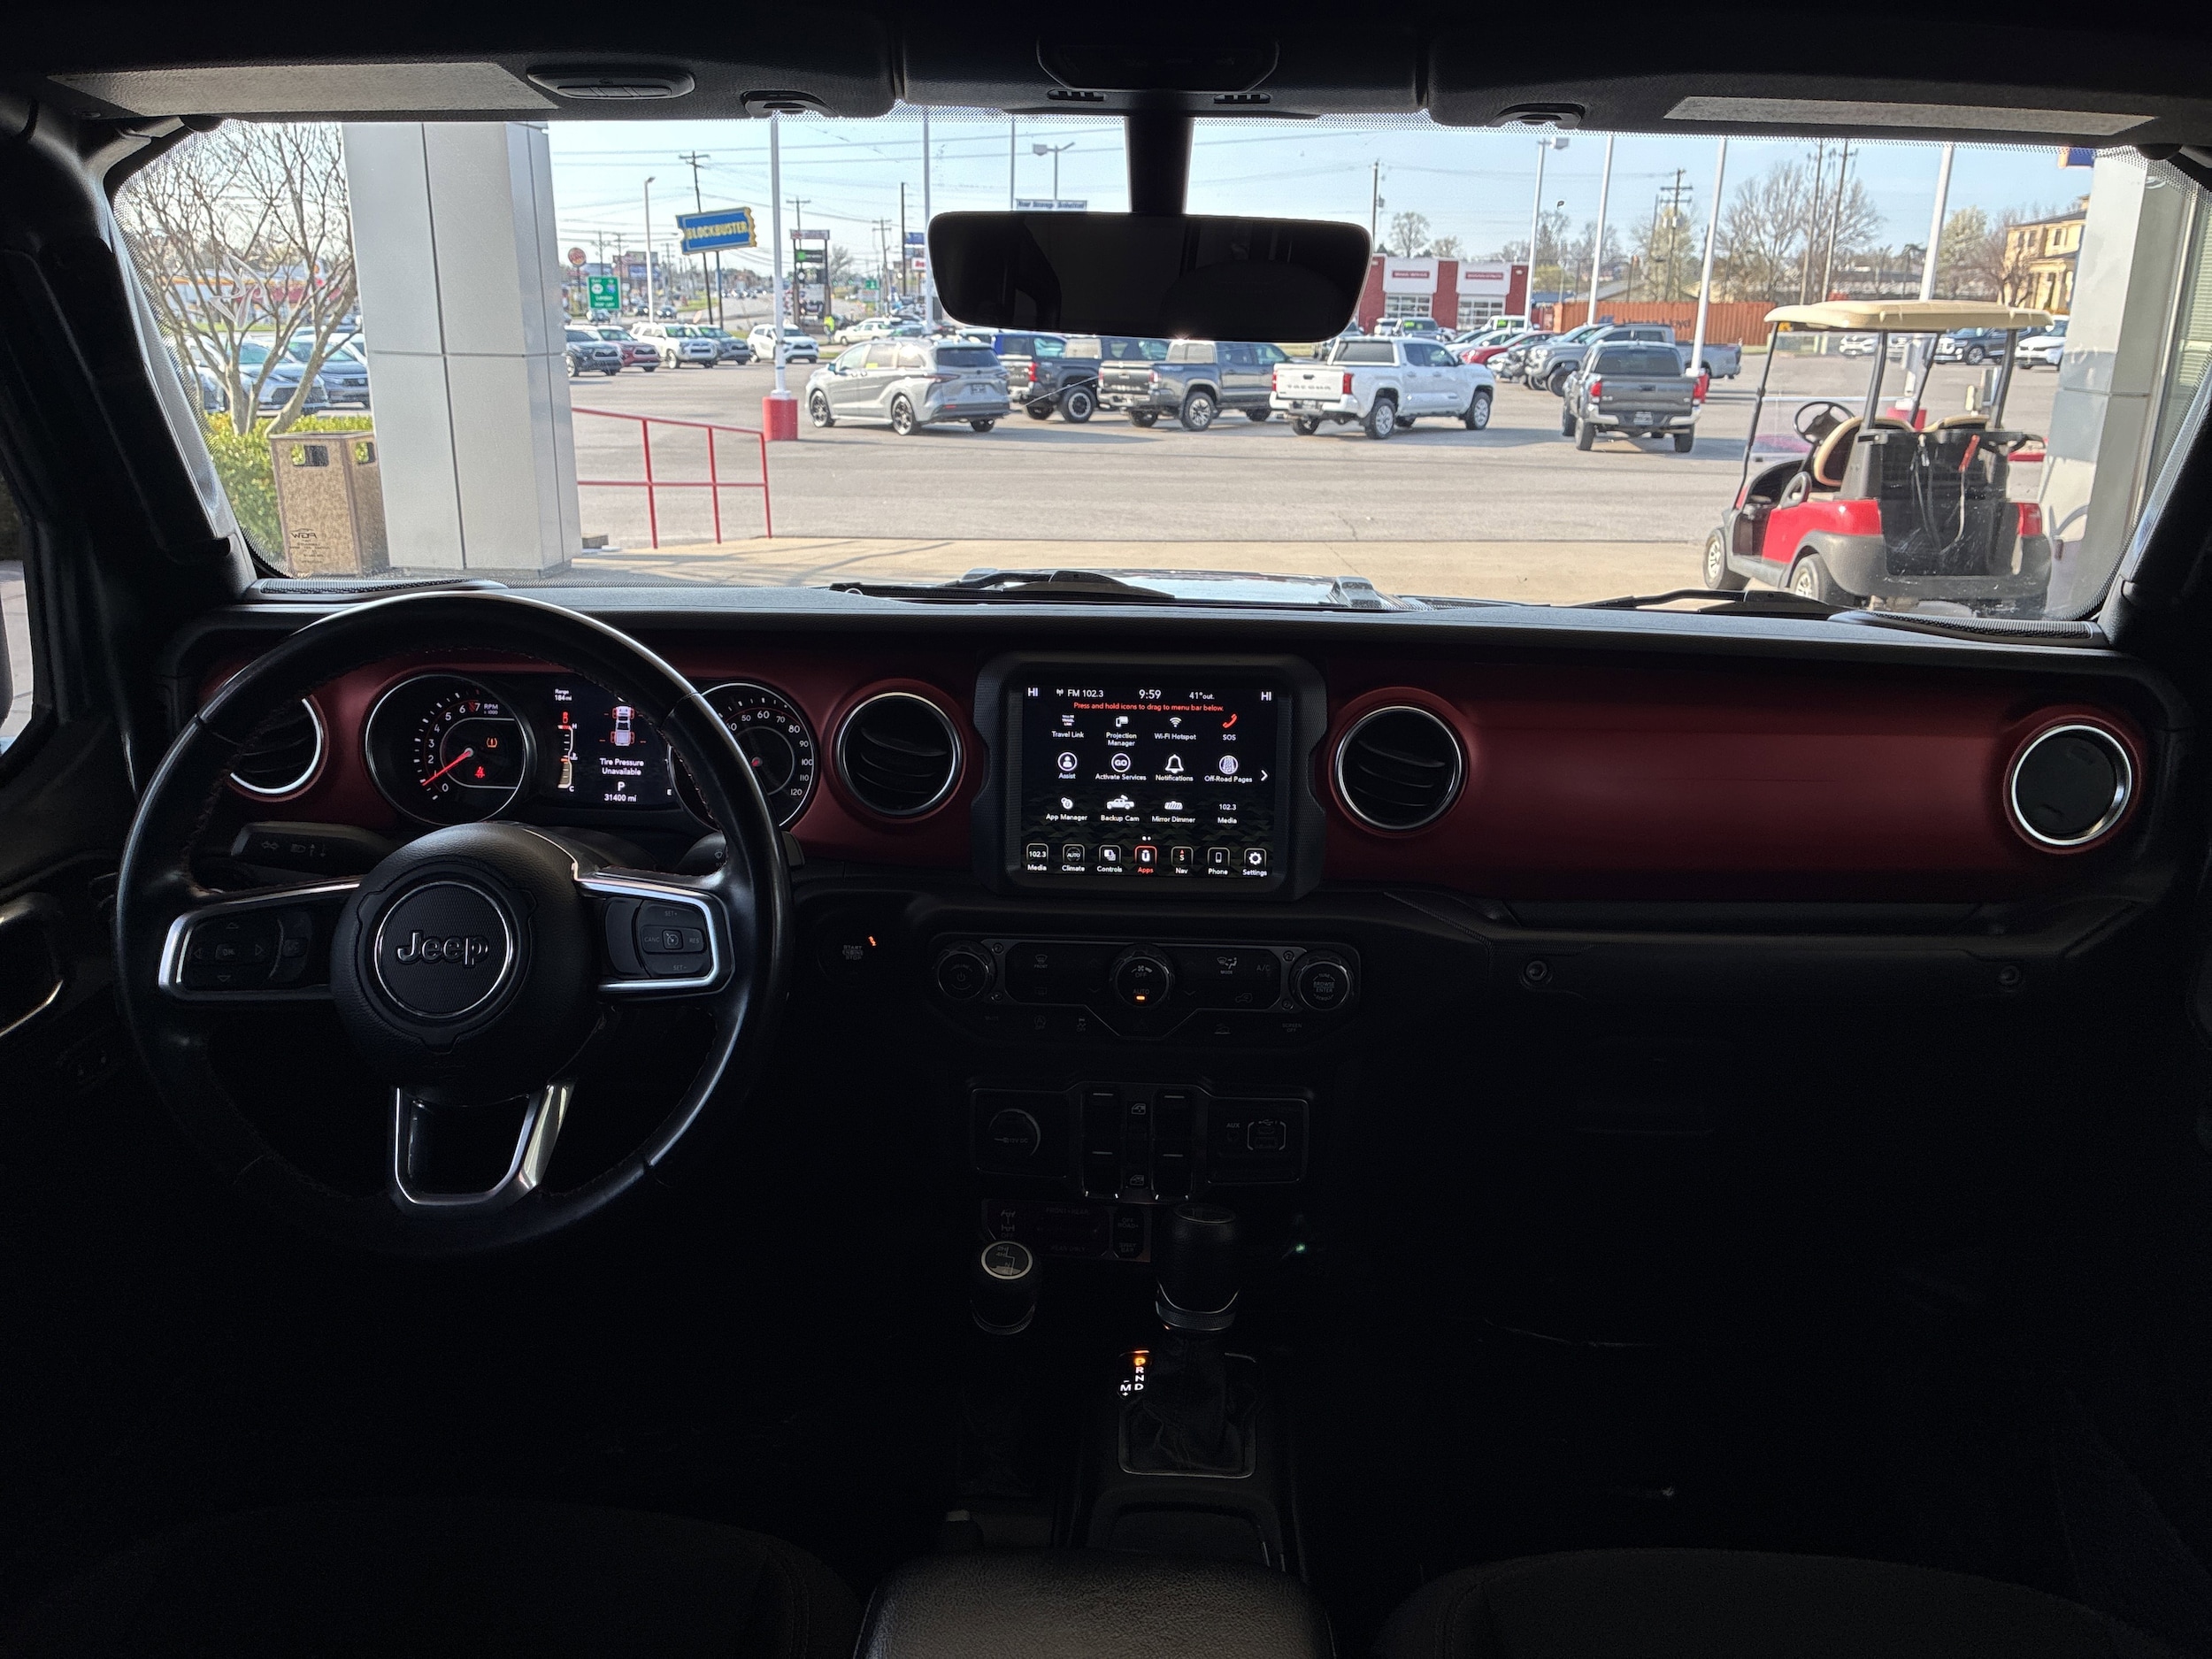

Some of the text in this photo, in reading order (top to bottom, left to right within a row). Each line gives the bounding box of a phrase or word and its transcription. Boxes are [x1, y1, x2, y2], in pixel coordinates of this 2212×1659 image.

[686, 221, 748, 240] BLOCKBUSTER
[1027, 687, 1039, 697] HI
[1139, 689, 1162, 699] 9:59
[1261, 691, 1272, 701] HI
[474, 703, 481, 711] 7
[445, 712, 451, 721] 5
[757, 710, 770, 719] 60
[788, 725, 800, 733] 80
[428, 739, 434, 748] 3
[428, 755, 434, 764] 2
[599, 757, 613, 766] Tire
[442, 783, 449, 792] 0
[618, 781, 626, 791] P
[397, 932, 488, 965] Jeep
[1134, 1357, 1146, 1366] P
